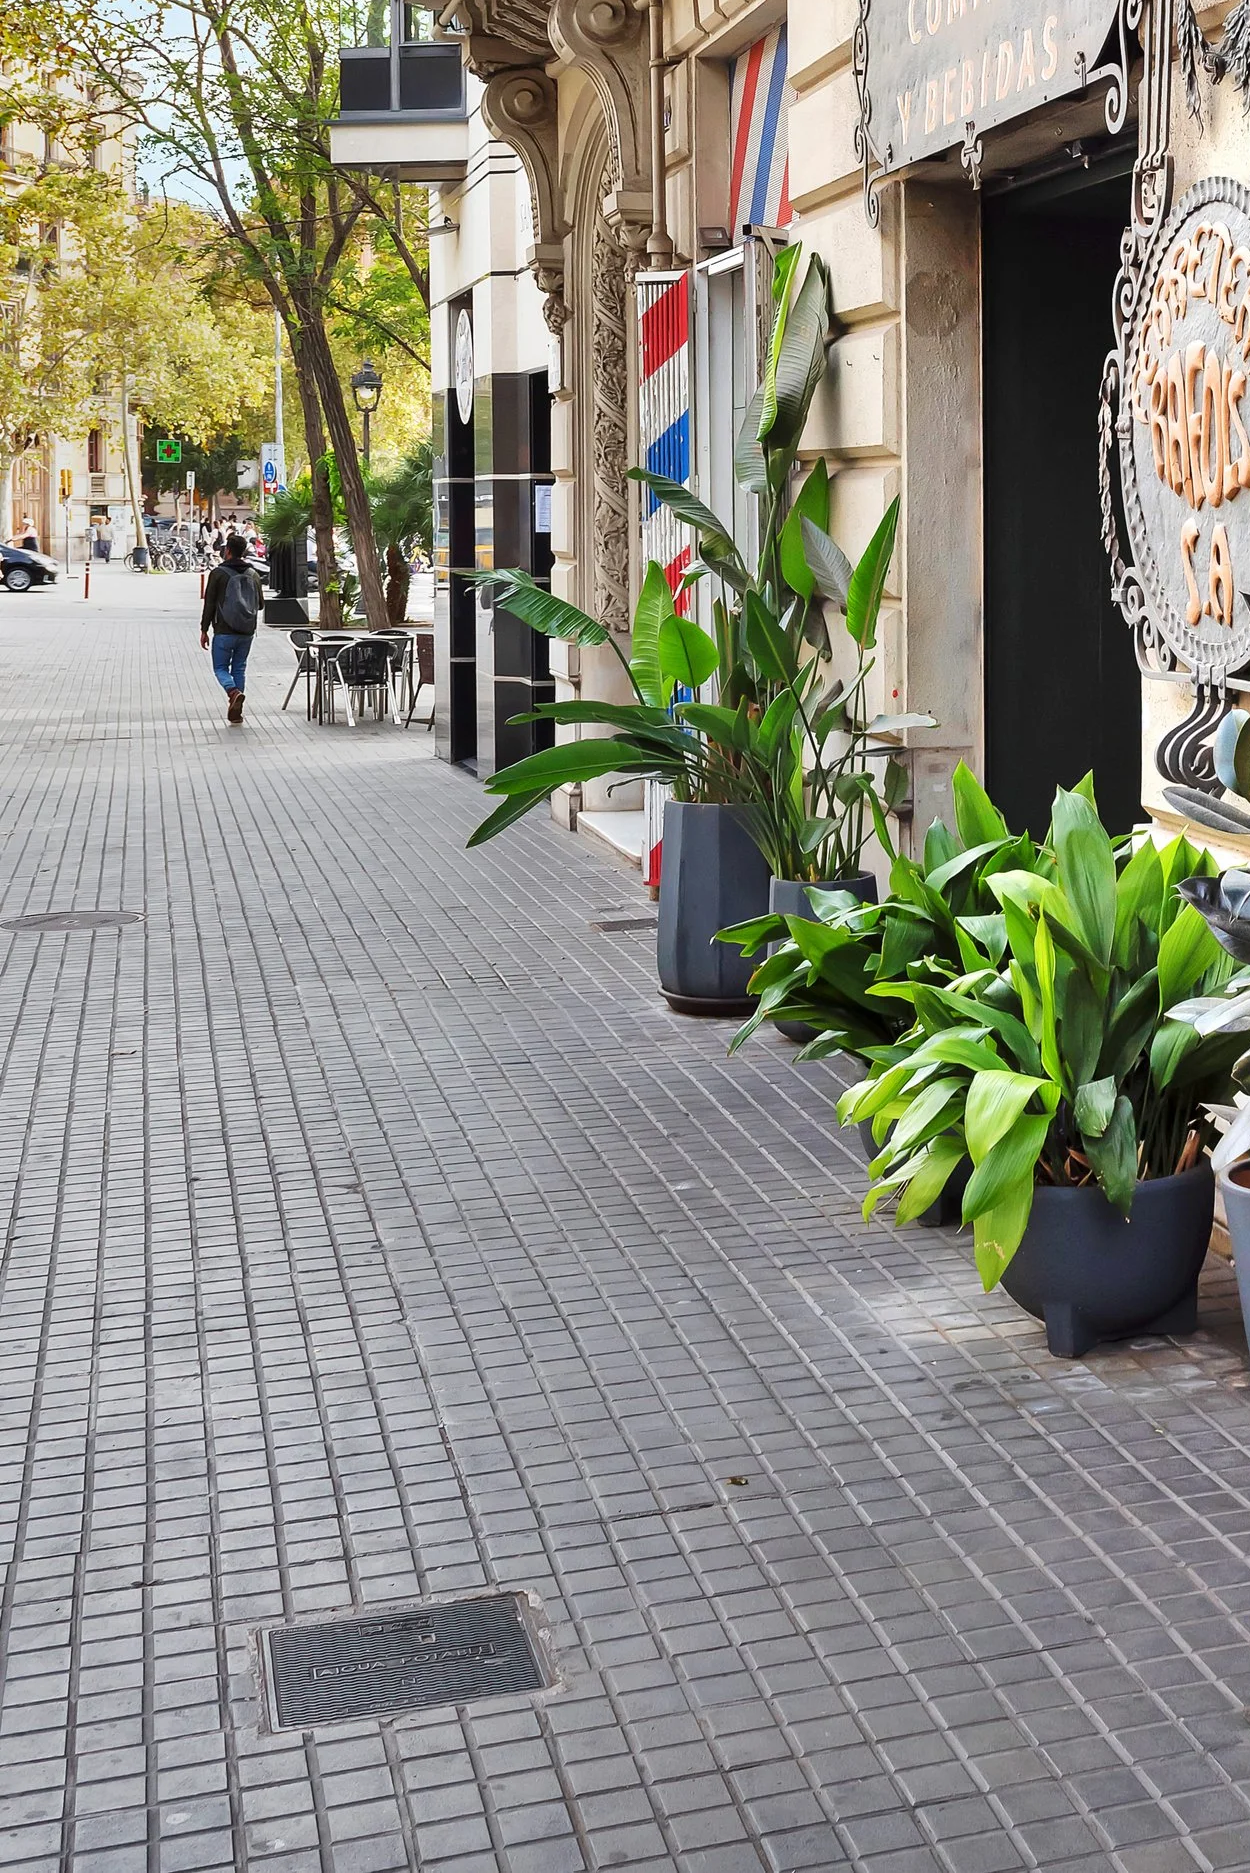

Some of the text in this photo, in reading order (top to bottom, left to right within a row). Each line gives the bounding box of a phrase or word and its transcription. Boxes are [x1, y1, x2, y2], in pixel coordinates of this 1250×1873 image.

[896, 15, 1058, 145] Y BEBIDAS
[319, 1643, 490, 1676] AIGUA POTABLE
